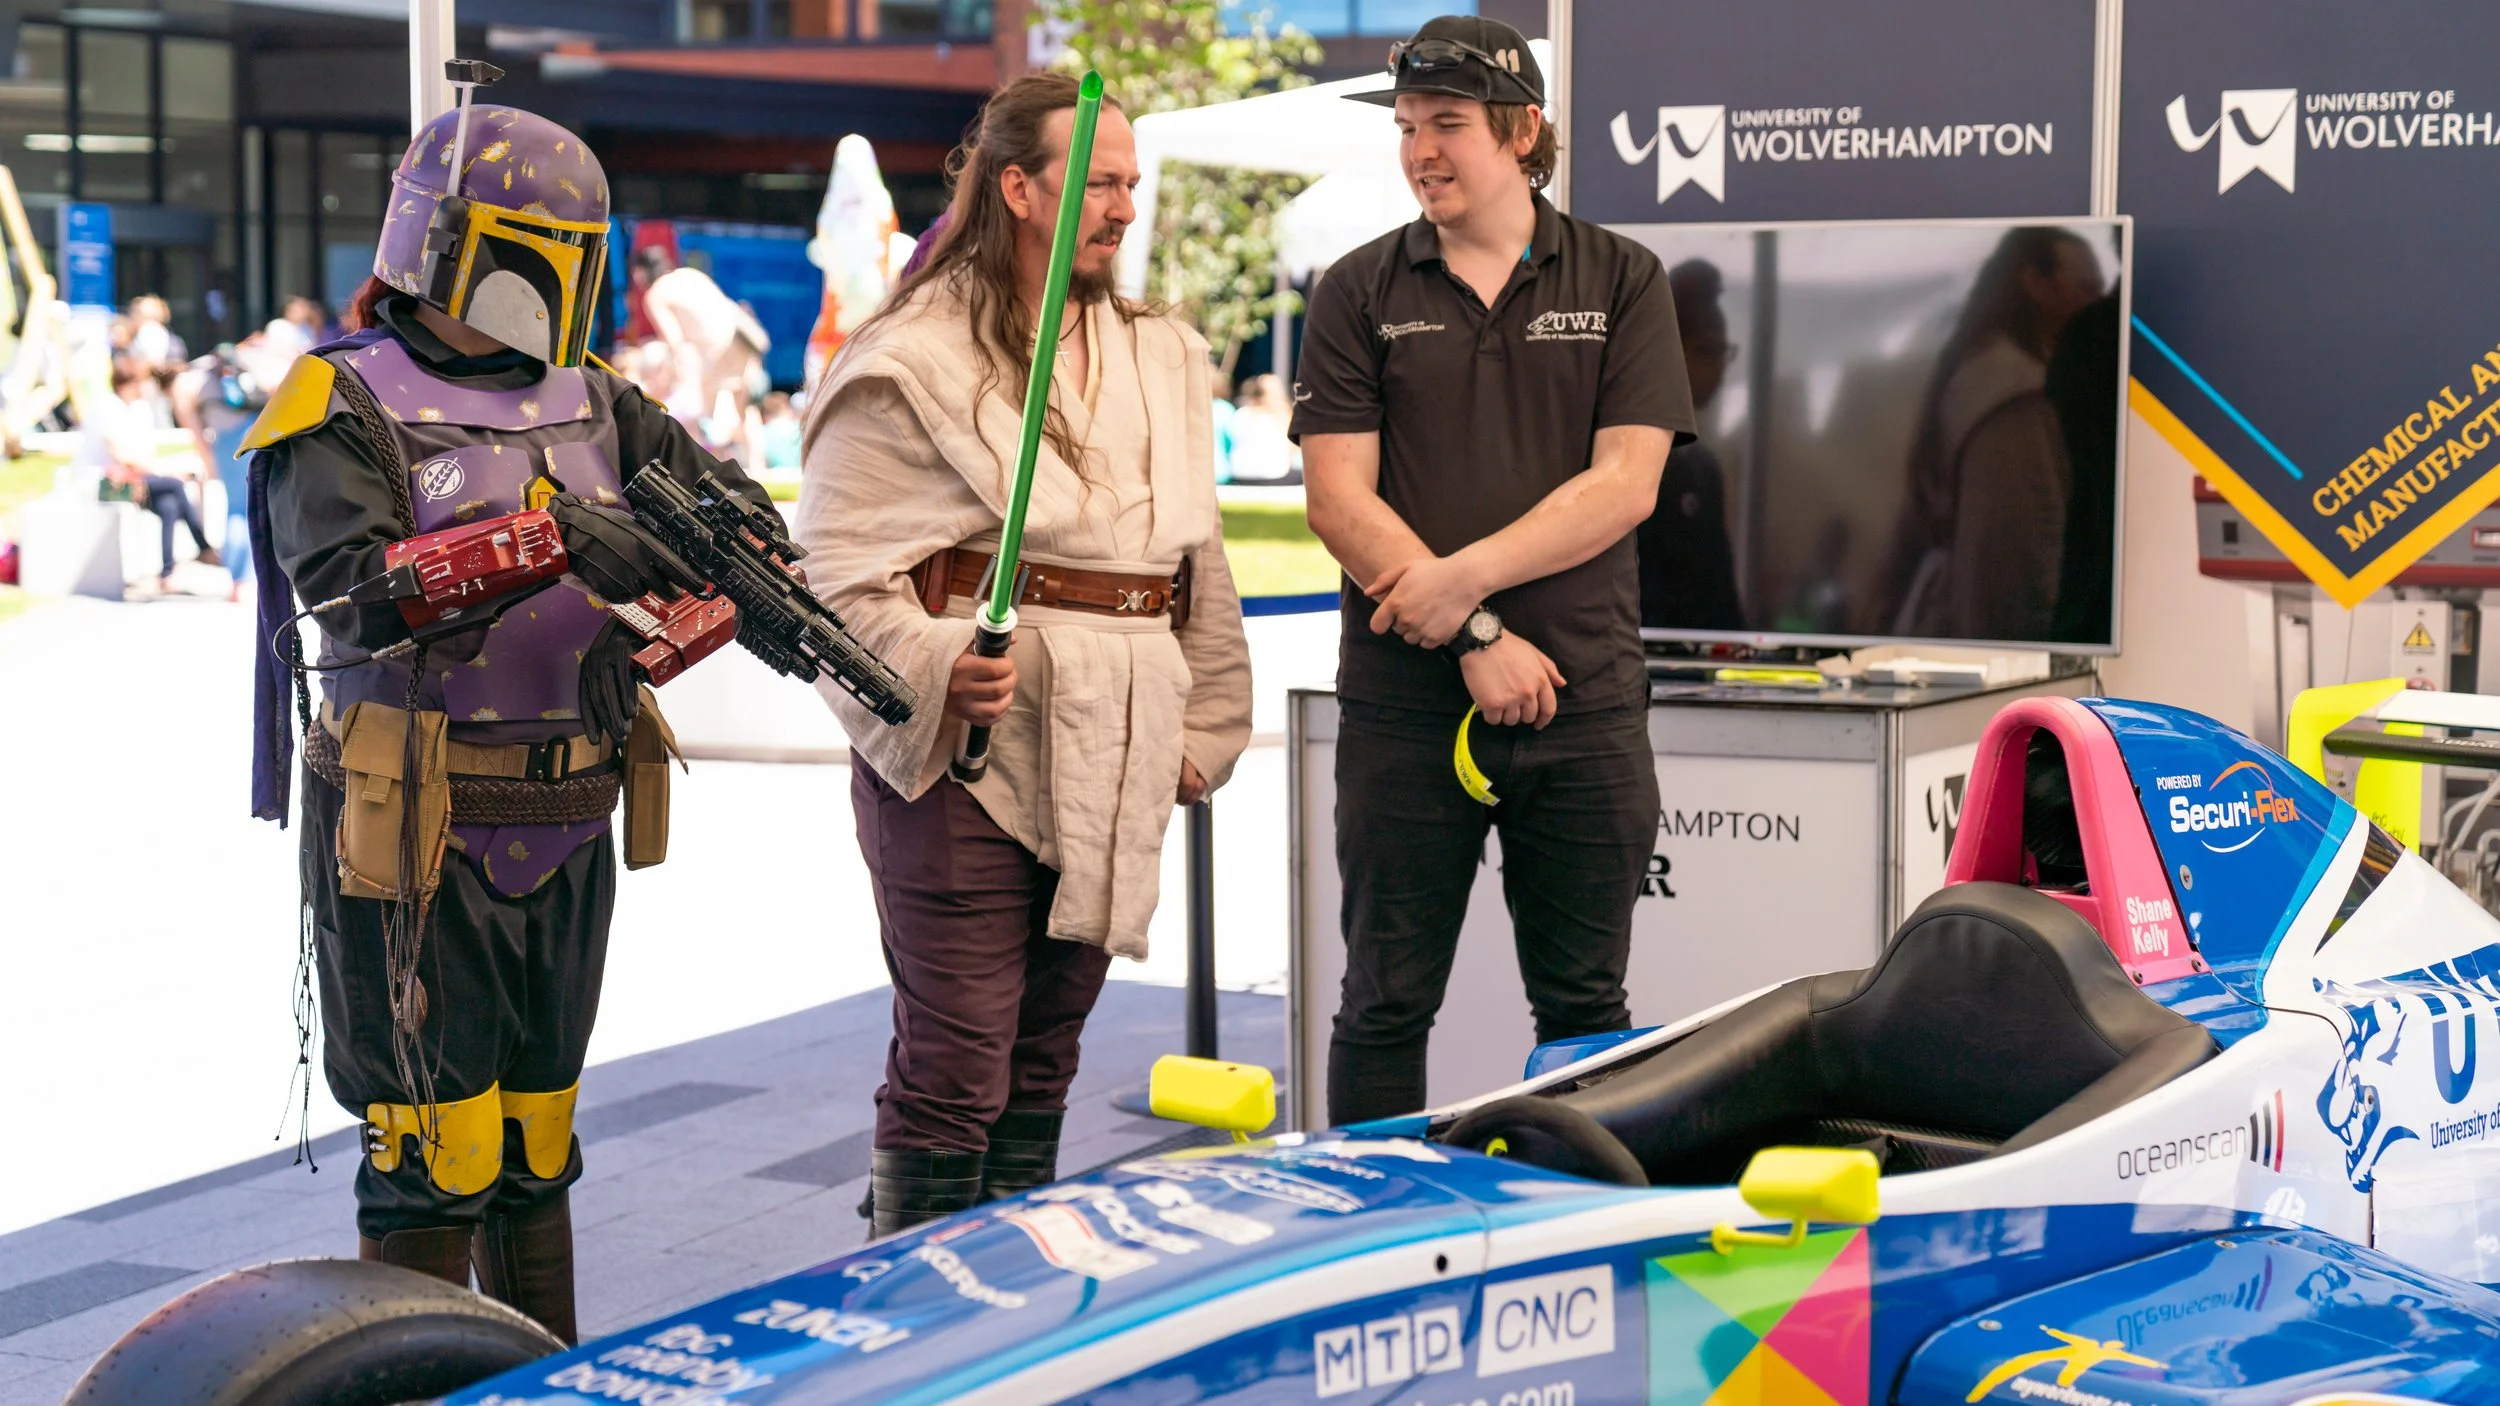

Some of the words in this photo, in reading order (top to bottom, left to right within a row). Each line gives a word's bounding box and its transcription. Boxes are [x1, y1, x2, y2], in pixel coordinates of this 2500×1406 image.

[1731, 107, 1832, 127] UNIVERSITY
[1837, 106, 1862, 125] OF
[2305, 90, 2421, 113] UNIVERSITY
[2426, 89, 2455, 111] OF
[1731, 122, 2054, 162] WOLVERHAMPTON
[1553, 311, 1608, 332] UWR
[2312, 386, 2473, 517] CHEMICAL
[2156, 775, 2192, 790] POWERED
[2191, 774, 2202, 787] BY
[2169, 789, 2300, 833] Securi-Flex
[2126, 896, 2172, 926] Shane
[2131, 926, 2170, 957] Kelly
[2430, 1109, 2487, 1149] University
[2117, 1124, 2247, 1180] oceanscan
[1321, 1319, 1453, 1387] MTD
[1494, 1286, 1598, 1353] CNC
